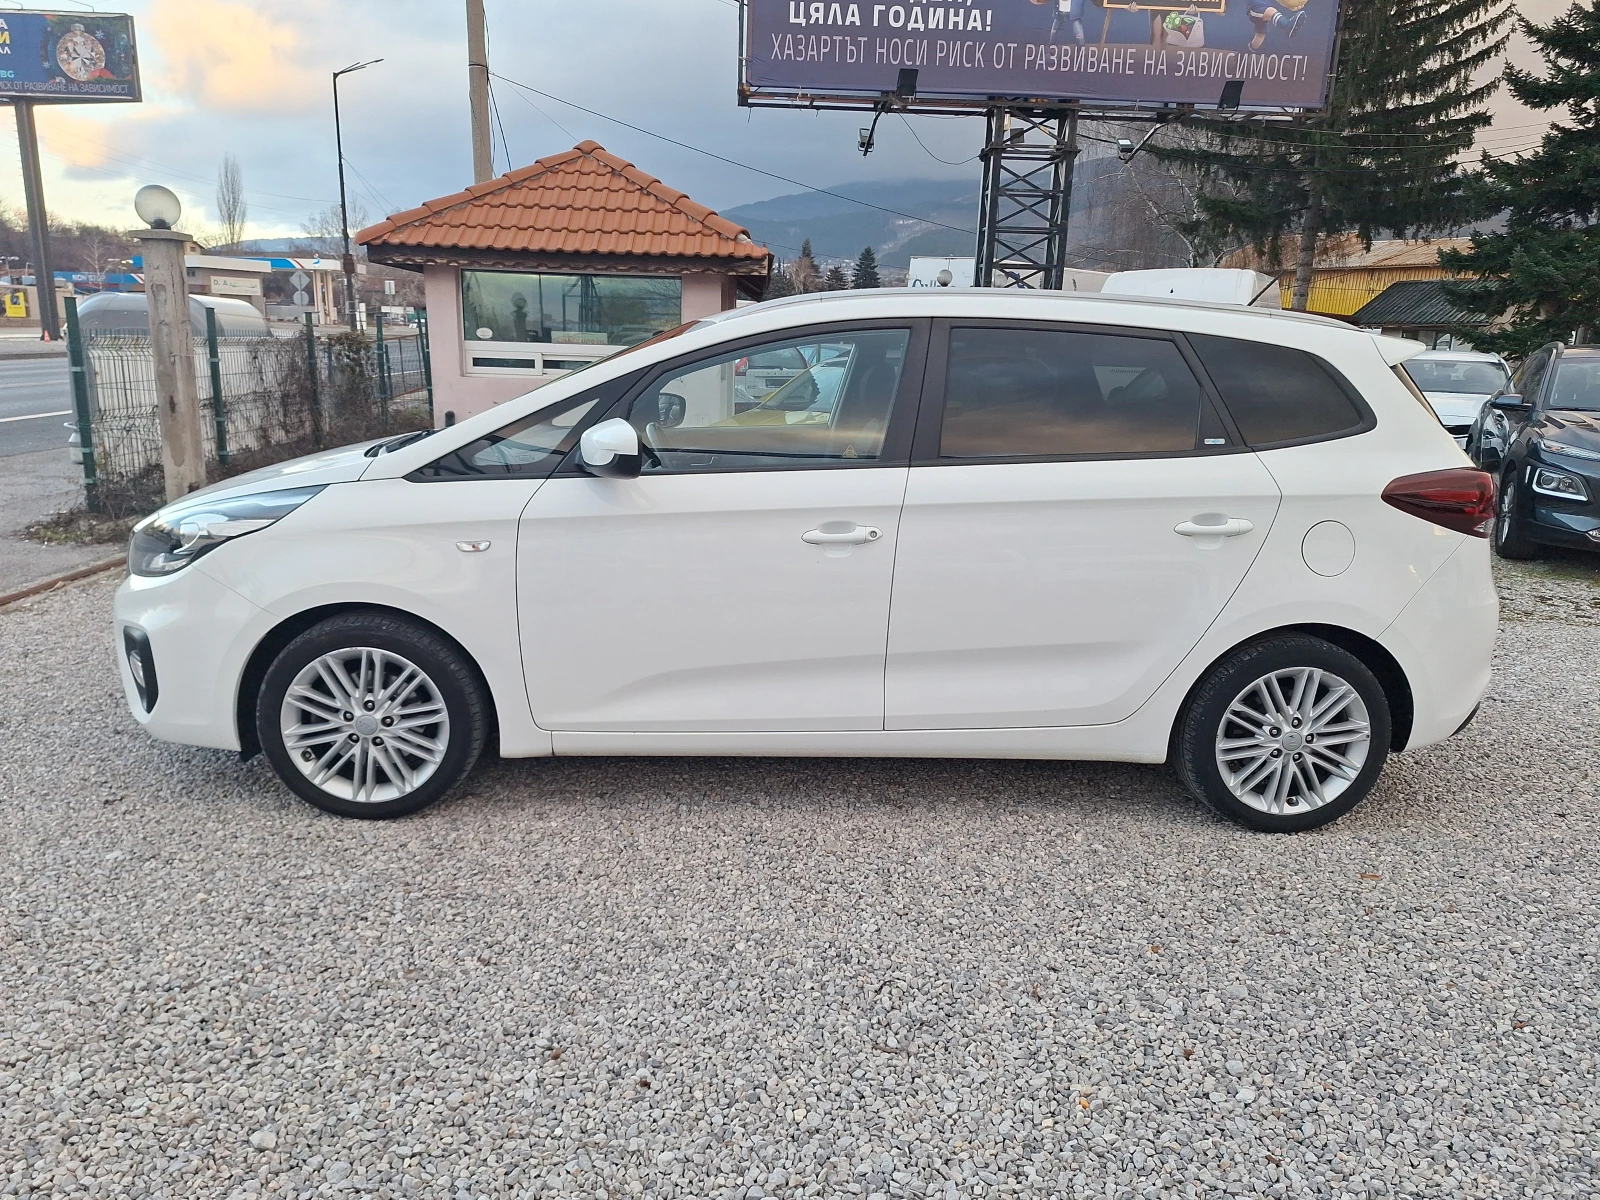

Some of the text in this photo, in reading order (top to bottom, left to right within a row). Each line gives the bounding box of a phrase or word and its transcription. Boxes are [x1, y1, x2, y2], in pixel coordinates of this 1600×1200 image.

[789, 1, 992, 32] ЦЯЛА ГОДИНА!
[771, 33, 1308, 81] ХАЗАРТЪТ НОСИ РИСК ОТ РАЗВИВАНЕ НА ЗАВИСИМОСТ!
[13, 81, 24, 90] ОТ
[24, 81, 68, 92] РАЗВИВАНЕ
[69, 83, 79, 92] НА
[80, 83, 129, 94] ЗАВИСИМОСТ
